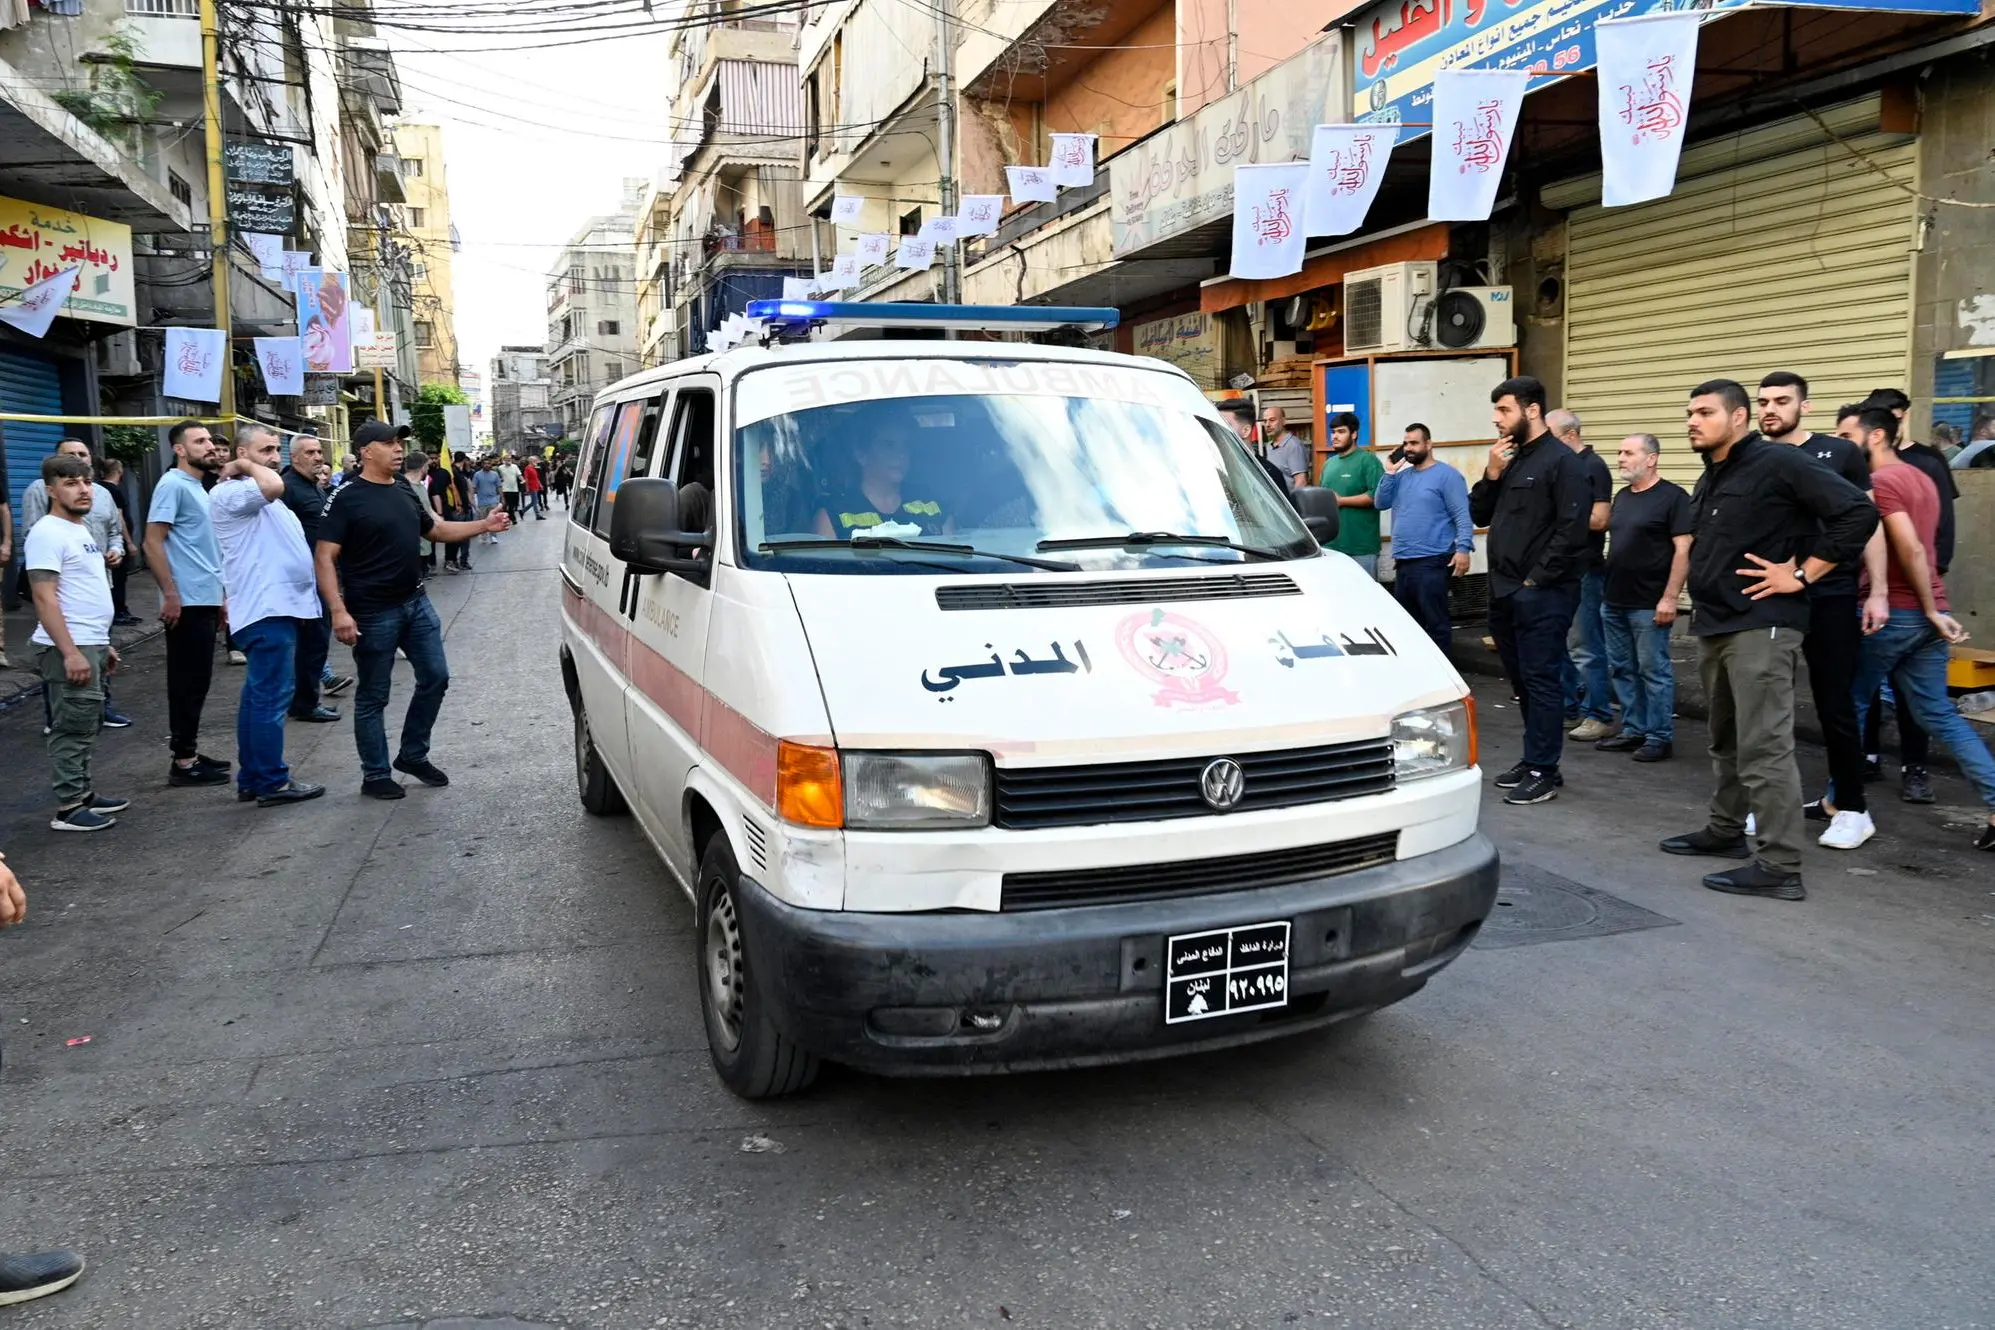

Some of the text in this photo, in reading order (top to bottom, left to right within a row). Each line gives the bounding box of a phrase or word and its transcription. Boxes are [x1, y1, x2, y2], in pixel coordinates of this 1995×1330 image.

[1509, 14, 1541, 41] جميع
[1545, 20, 1580, 51] نحاس
[1553, 45, 1580, 70] 56
[1619, 85, 1636, 124] لبيك
[1214, 90, 1280, 164] ماركت
[1452, 121, 1466, 156] لبيك
[1327, 150, 1341, 180] لبيك
[29, 210, 77, 233] خدمة
[0, 224, 118, 271] ردياتير اشكم
[643, 597, 680, 638] AMBULANCE
[921, 639, 1092, 703] المدني
